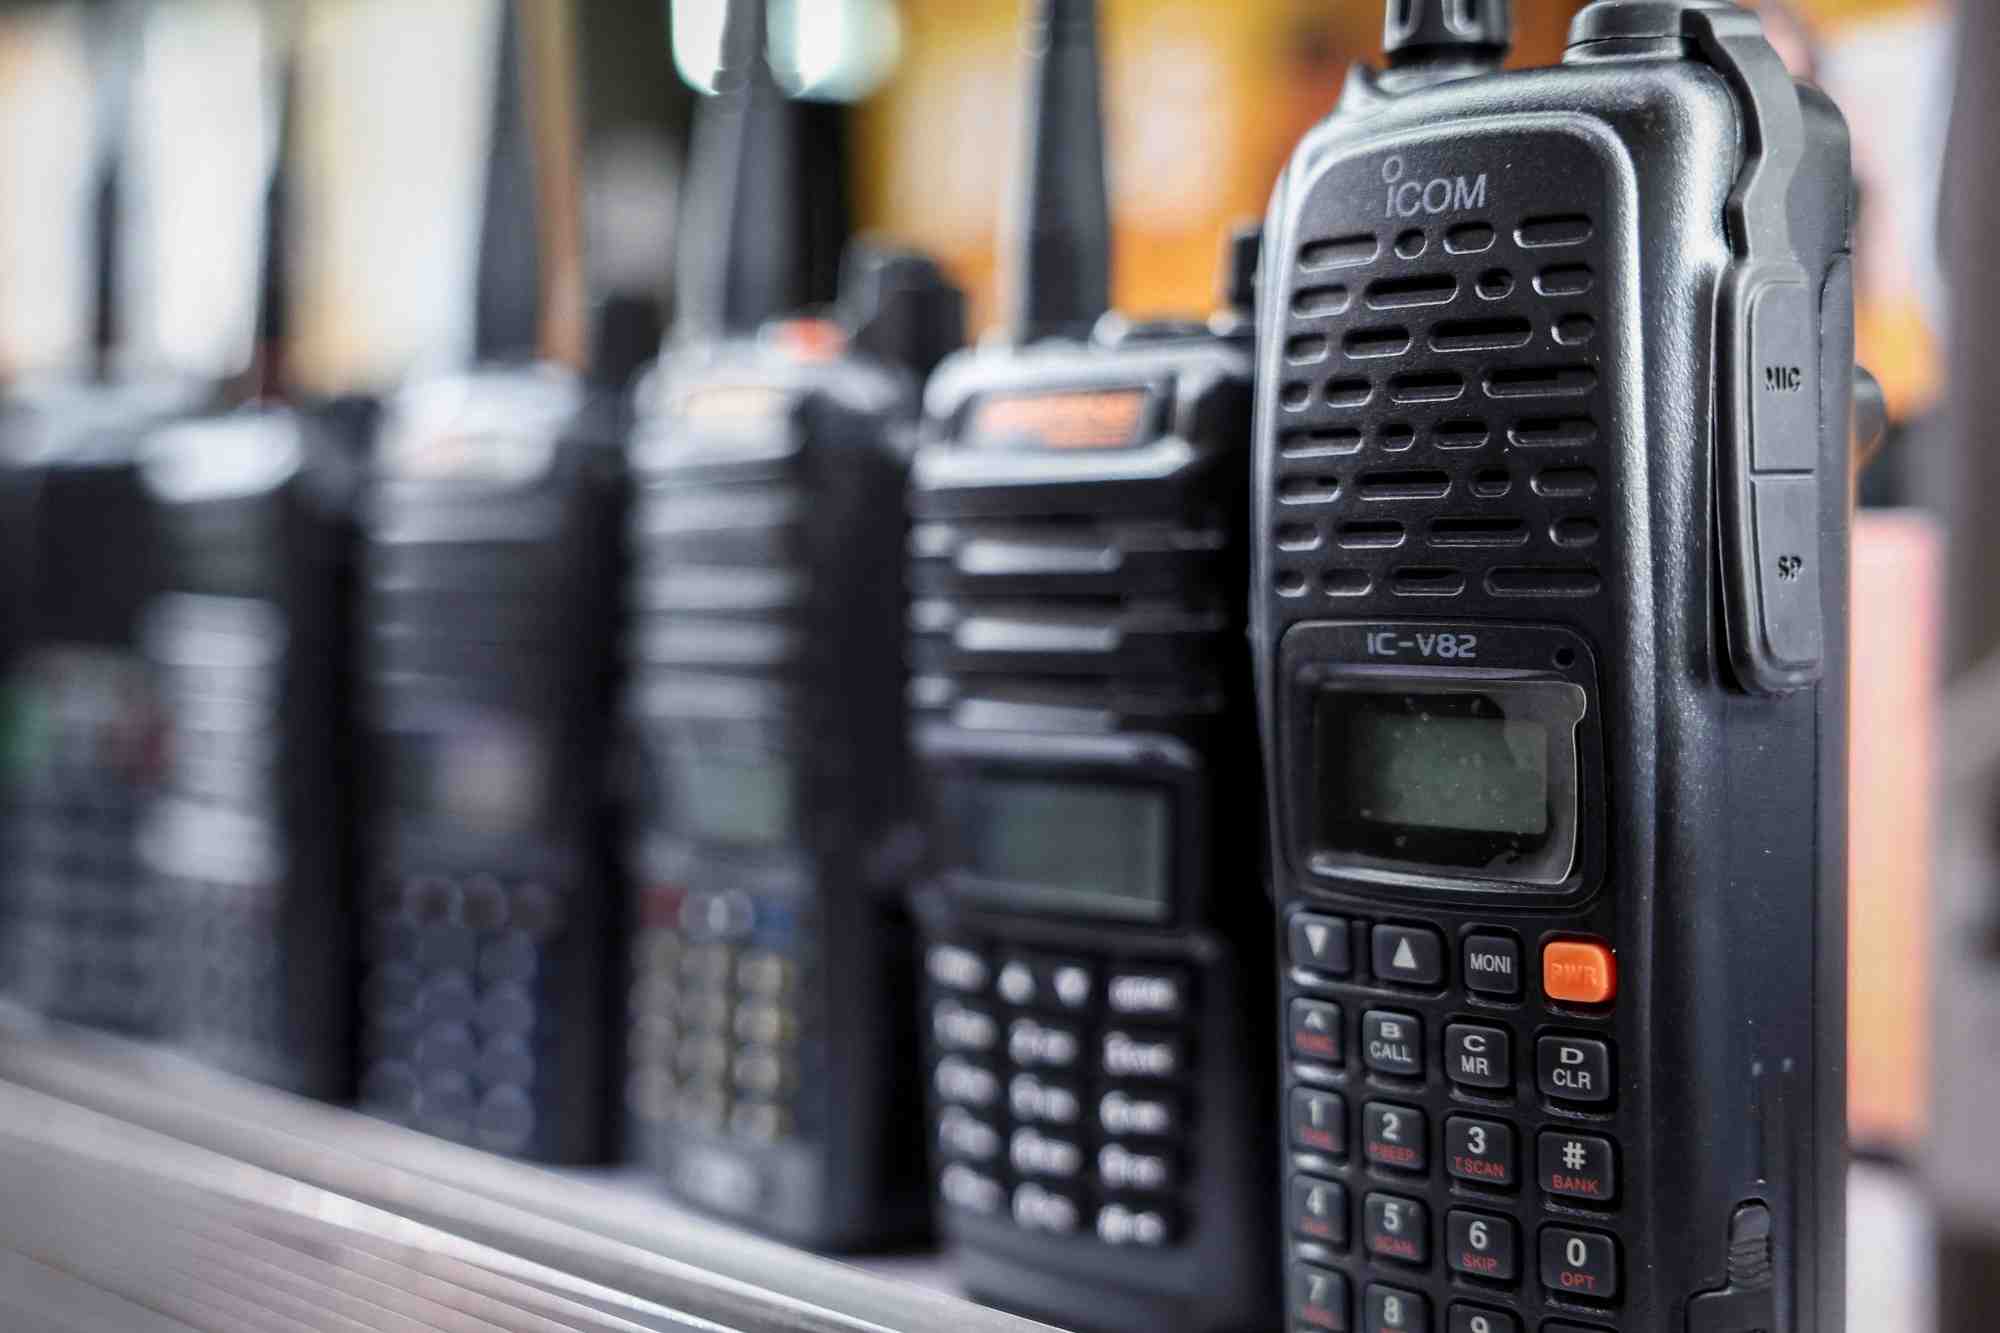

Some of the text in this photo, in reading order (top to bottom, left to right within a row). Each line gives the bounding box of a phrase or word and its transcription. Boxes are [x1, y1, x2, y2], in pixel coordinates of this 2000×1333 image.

[1766, 366, 1801, 391] MIC
[1778, 555, 1803, 580] SP
[1366, 632, 1478, 658] IC-V82
[1470, 953, 1511, 974] MONI
[1381, 1023, 1401, 1038] B
[1369, 1042, 1412, 1062] CALL
[1463, 1036, 1487, 1051] C
[1560, 1048, 1584, 1064] D
[1461, 1056, 1488, 1075] MR
[1553, 1069, 1591, 1090] CLR
[1309, 1099, 1320, 1127] 1
[1382, 1113, 1399, 1140] 2
[1468, 1126, 1486, 1154] 3
[1562, 1141, 1585, 1170] #
[1552, 1174, 1600, 1194] BANK
[1307, 1187, 1323, 1215] 4
[1383, 1203, 1399, 1231] 5
[1469, 1221, 1487, 1249] 6
[1462, 1253, 1497, 1272] SKIP
[1566, 1237, 1586, 1267] 0
[1308, 1274, 1325, 1303] 7
[1560, 1271, 1597, 1289] OPT
[1383, 1295, 1401, 1324] 8
[1470, 1315, 1489, 1333] 9
